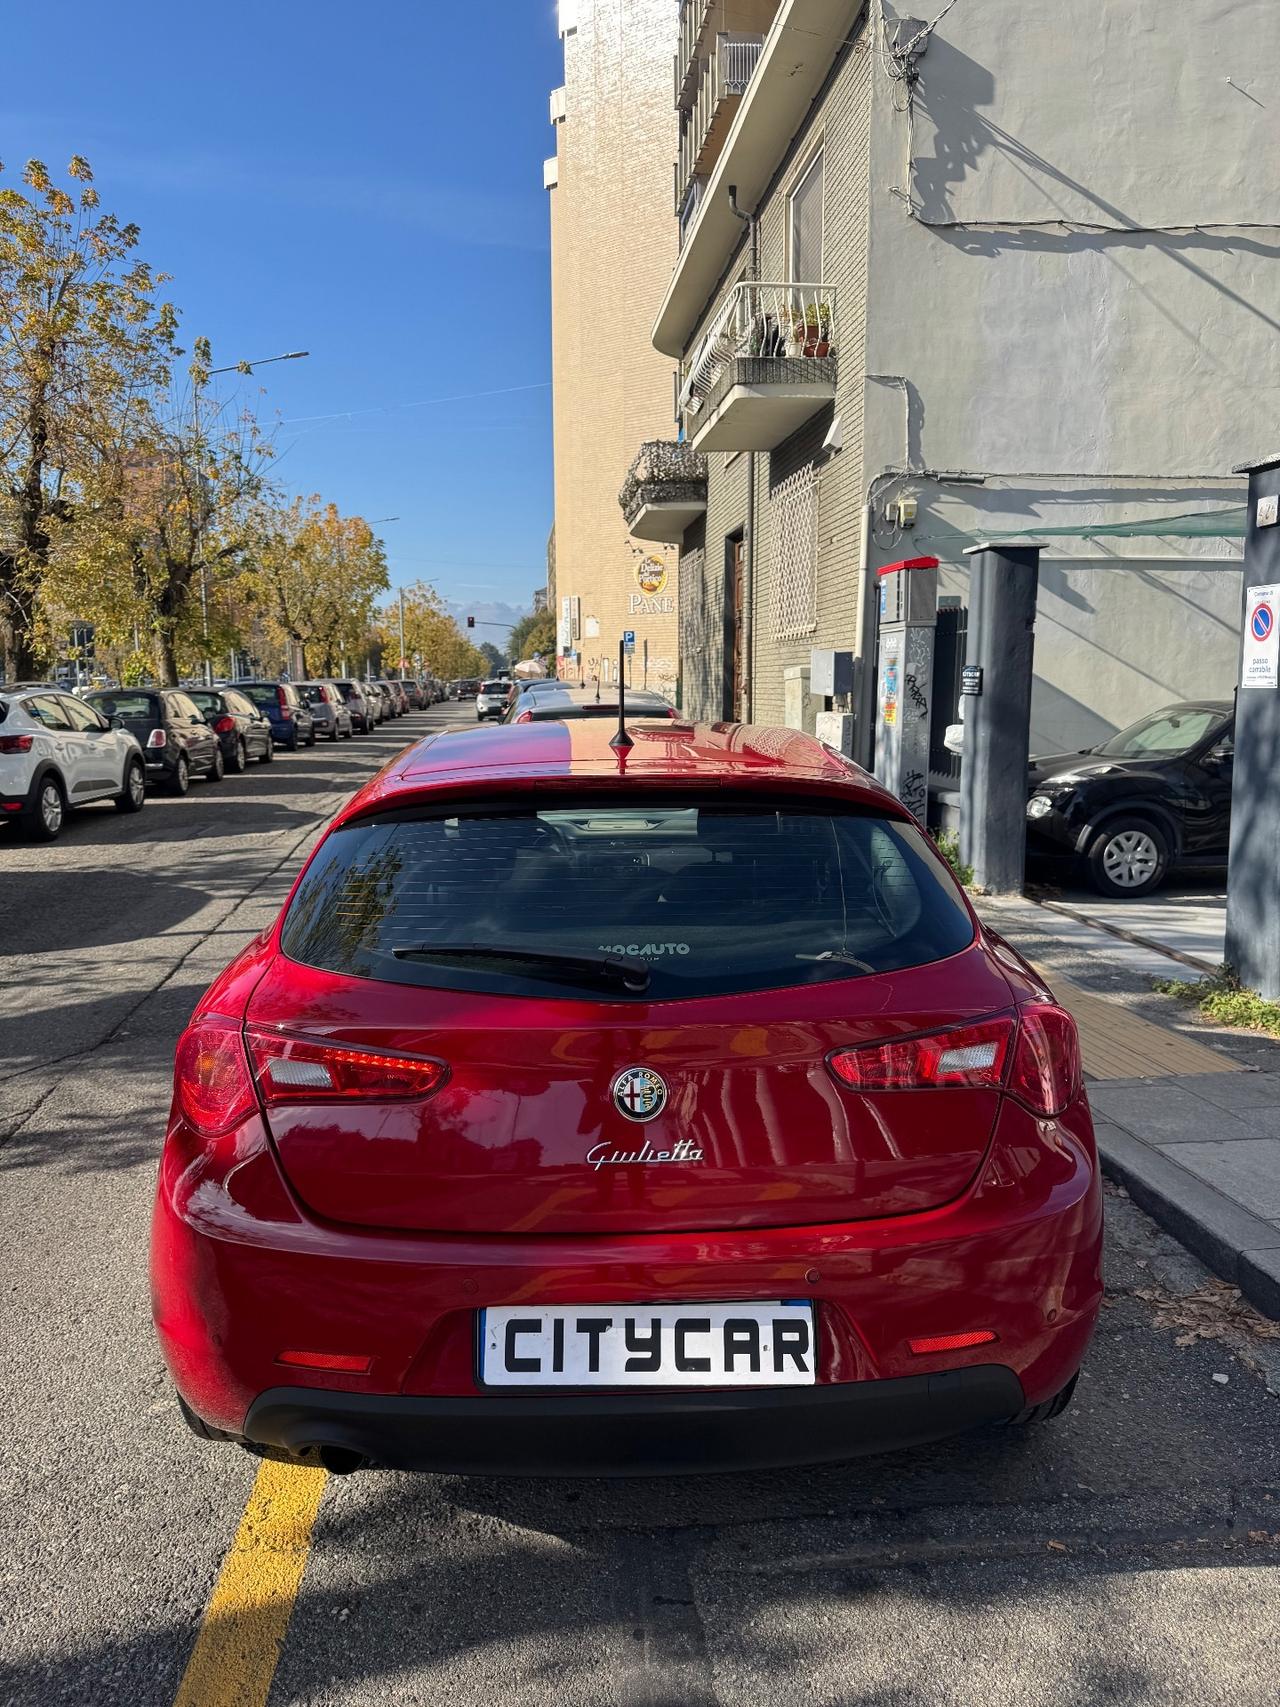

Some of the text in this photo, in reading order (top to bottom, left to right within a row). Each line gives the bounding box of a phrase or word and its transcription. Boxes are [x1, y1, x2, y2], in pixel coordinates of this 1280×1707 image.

[628, 593, 674, 615] PANE
[1249, 665, 1271, 673] carrabile
[617, 1071, 664, 1097] ALFA ROMEO
[586, 1139, 705, 1171] Giulietta
[504, 1318, 810, 1373] CITYCAR
